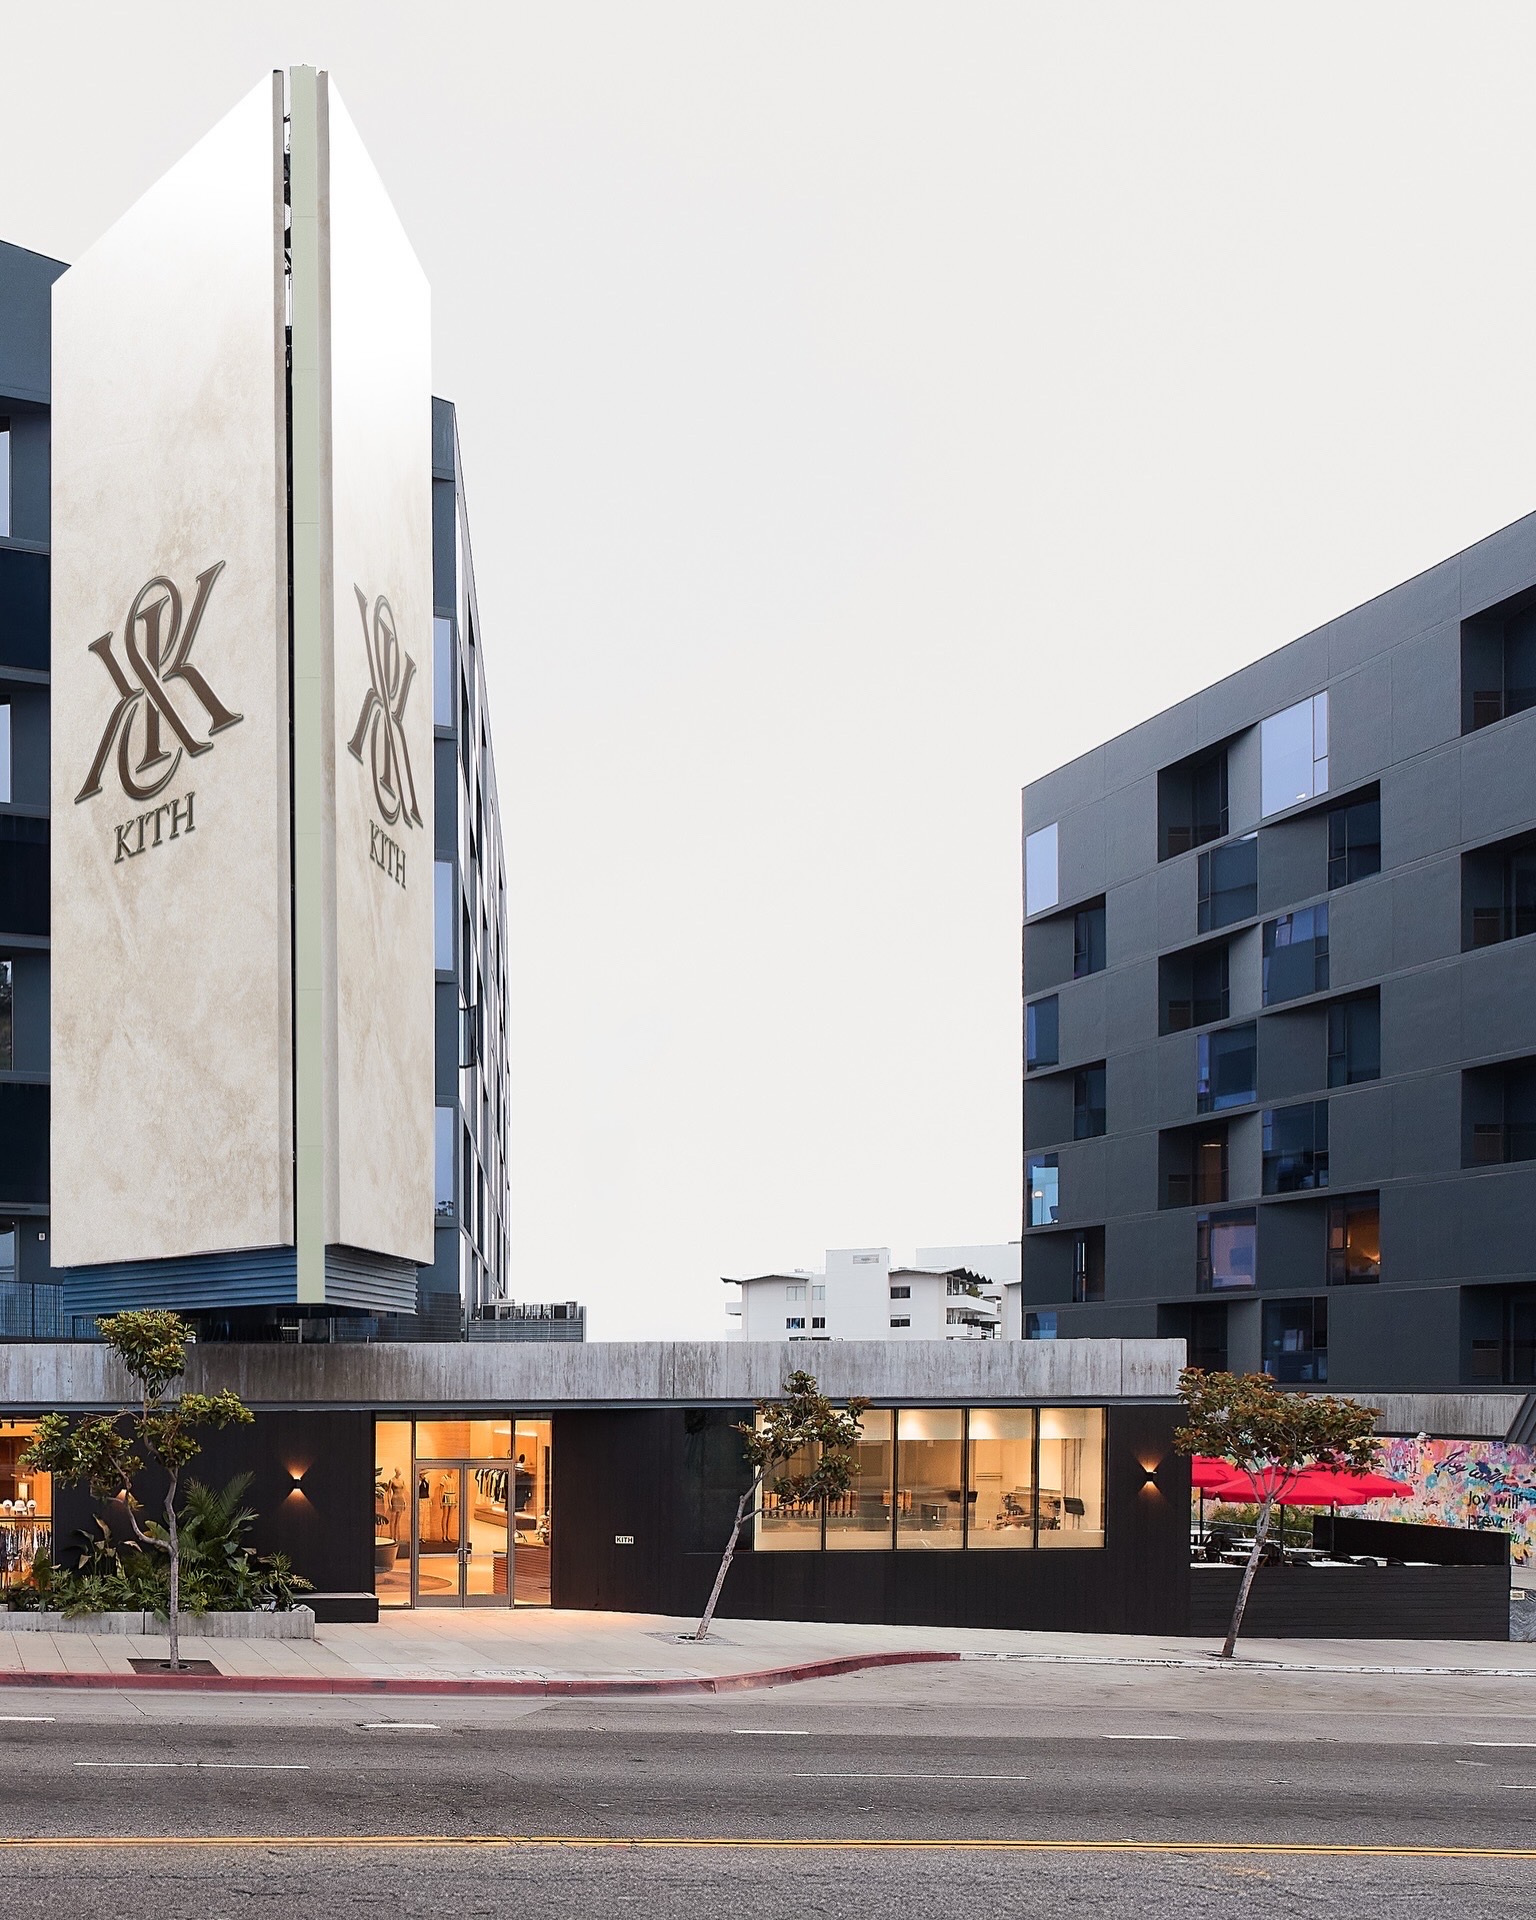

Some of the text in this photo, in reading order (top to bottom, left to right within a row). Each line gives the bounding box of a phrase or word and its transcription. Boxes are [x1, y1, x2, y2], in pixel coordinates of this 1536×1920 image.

[114, 791, 196, 864] KITH
[369, 819, 406, 889] KITH
[1467, 1490, 1491, 1509] Joy
[1495, 1494, 1518, 1509] will
